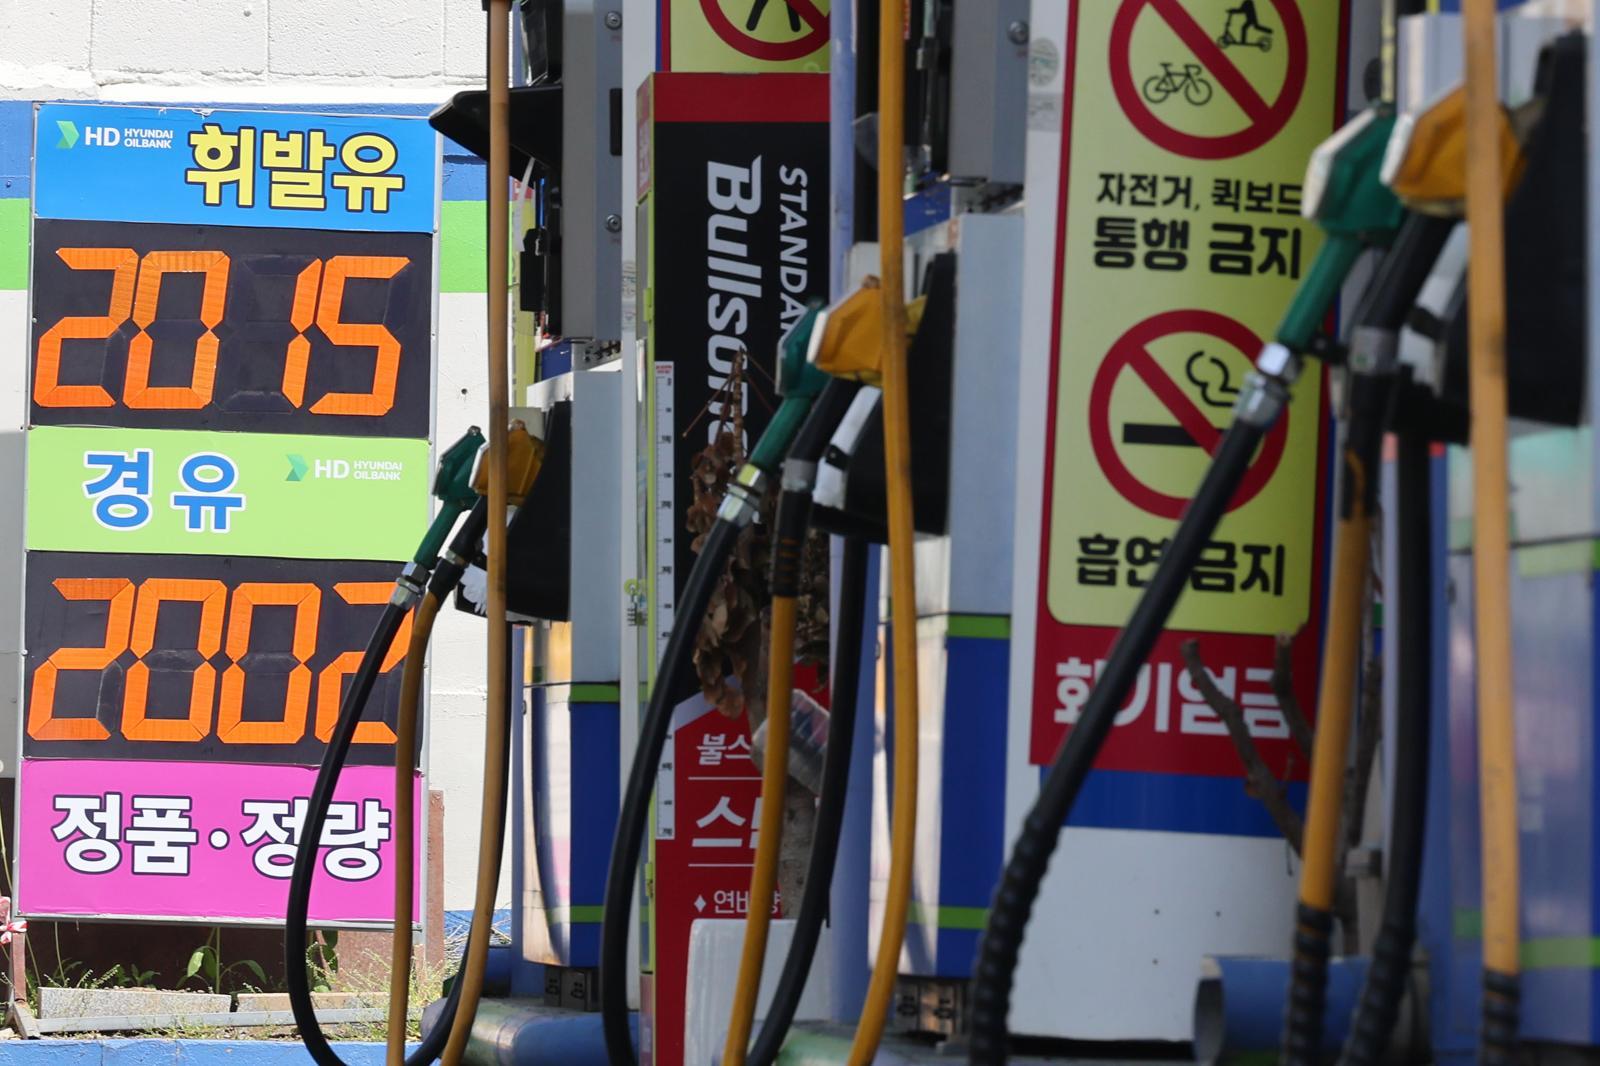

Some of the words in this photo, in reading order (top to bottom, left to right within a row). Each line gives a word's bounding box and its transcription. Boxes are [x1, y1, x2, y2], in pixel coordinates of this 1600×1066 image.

[84, 126, 120, 147] HD
[124, 128, 174, 139] HYUNDAI
[123, 138, 173, 149] OILBANK
[184, 122, 405, 213] 휘발유
[1096, 172, 1200, 212] 자전거,
[1093, 217, 1190, 272] 통행
[1208, 222, 1302, 280] 금지
[33, 246, 411, 417] 2015
[314, 458, 350, 480] HD
[353, 460, 403, 471] HYUNDAI
[353, 470, 402, 481] OILBANK
[27, 577, 415, 744] 2002
[697, 733, 752, 766] 불스
